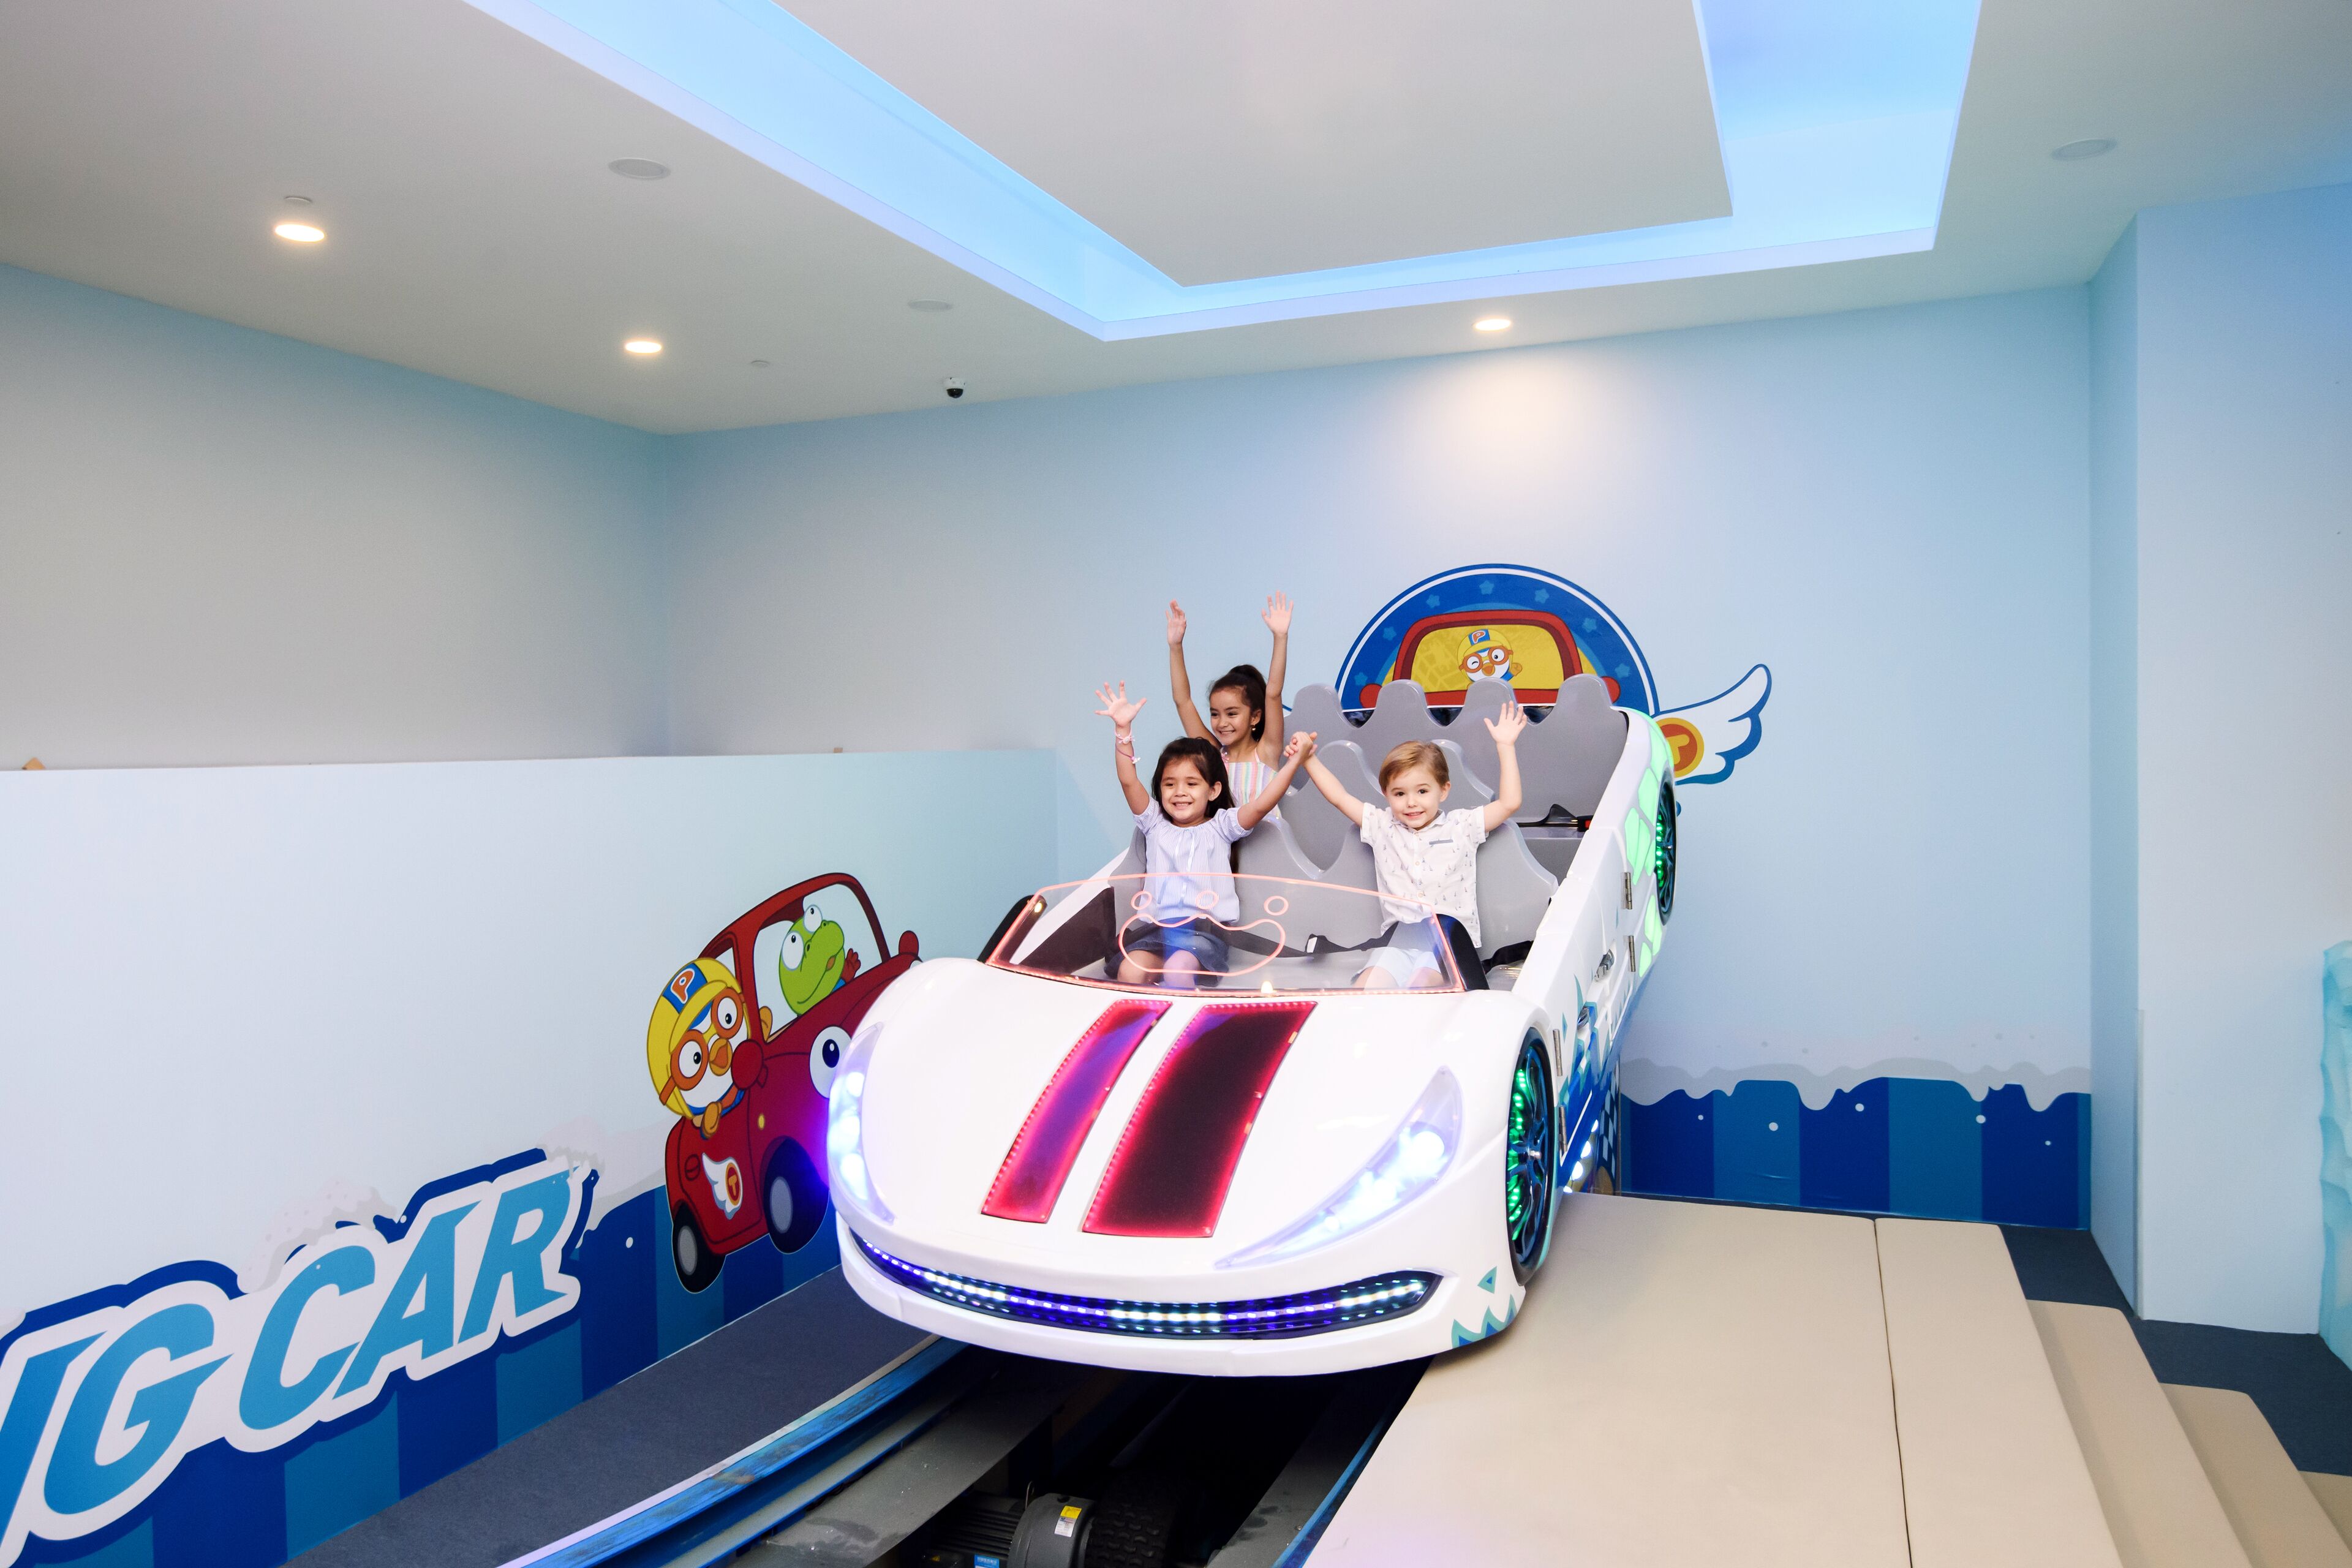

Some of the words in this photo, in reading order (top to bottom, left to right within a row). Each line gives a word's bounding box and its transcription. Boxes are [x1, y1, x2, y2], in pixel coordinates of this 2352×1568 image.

[1472, 631, 1486, 644] P
[671, 968, 695, 1004] P
[239, 1165, 581, 1430] CAR
